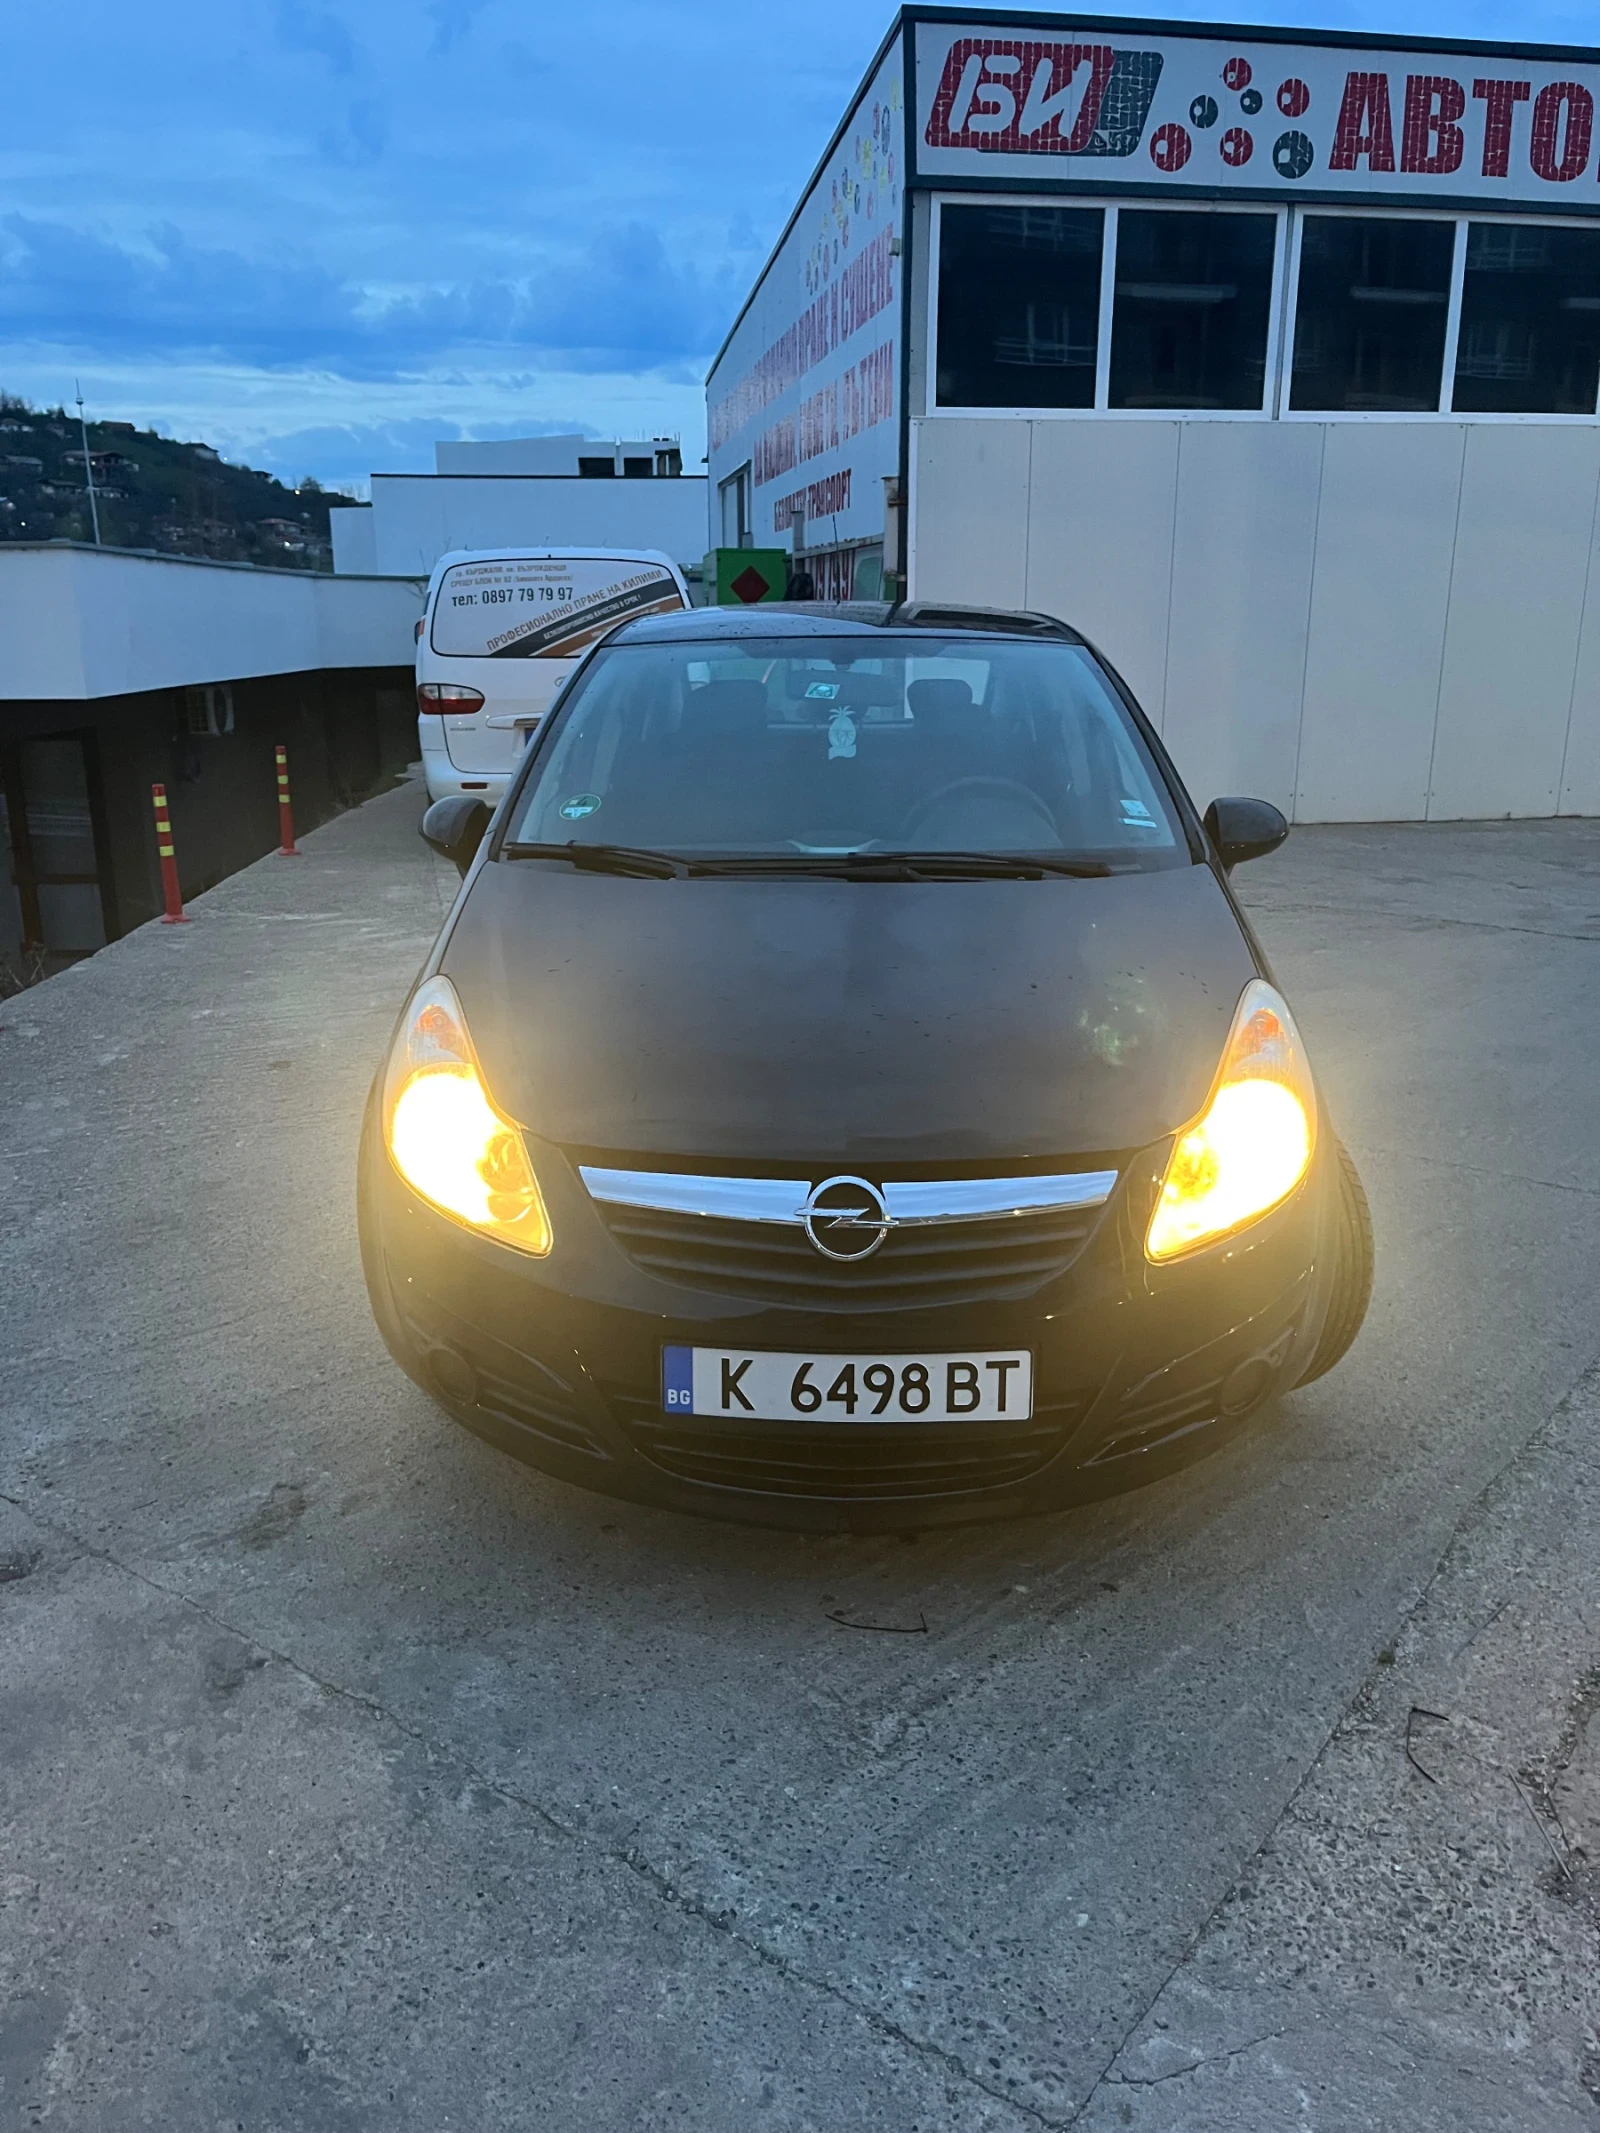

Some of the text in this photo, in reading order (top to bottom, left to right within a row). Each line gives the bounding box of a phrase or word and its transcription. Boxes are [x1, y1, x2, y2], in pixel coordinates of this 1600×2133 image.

[1328, 71, 1600, 183] АВТО
[808, 468, 851, 521] ТРАНСПОРТ
[452, 586, 573, 607] тел: 0897 79 79 97
[487, 604, 573, 651] ПРОФЕСИОНАЛНО
[573, 589, 607, 611] ПРАНЕ
[606, 583, 622, 597] НА
[621, 569, 664, 590] КИЛИМИ
[667, 1387, 692, 1405] BG
[720, 1357, 757, 1412] K
[790, 1360, 931, 1415] 6498
